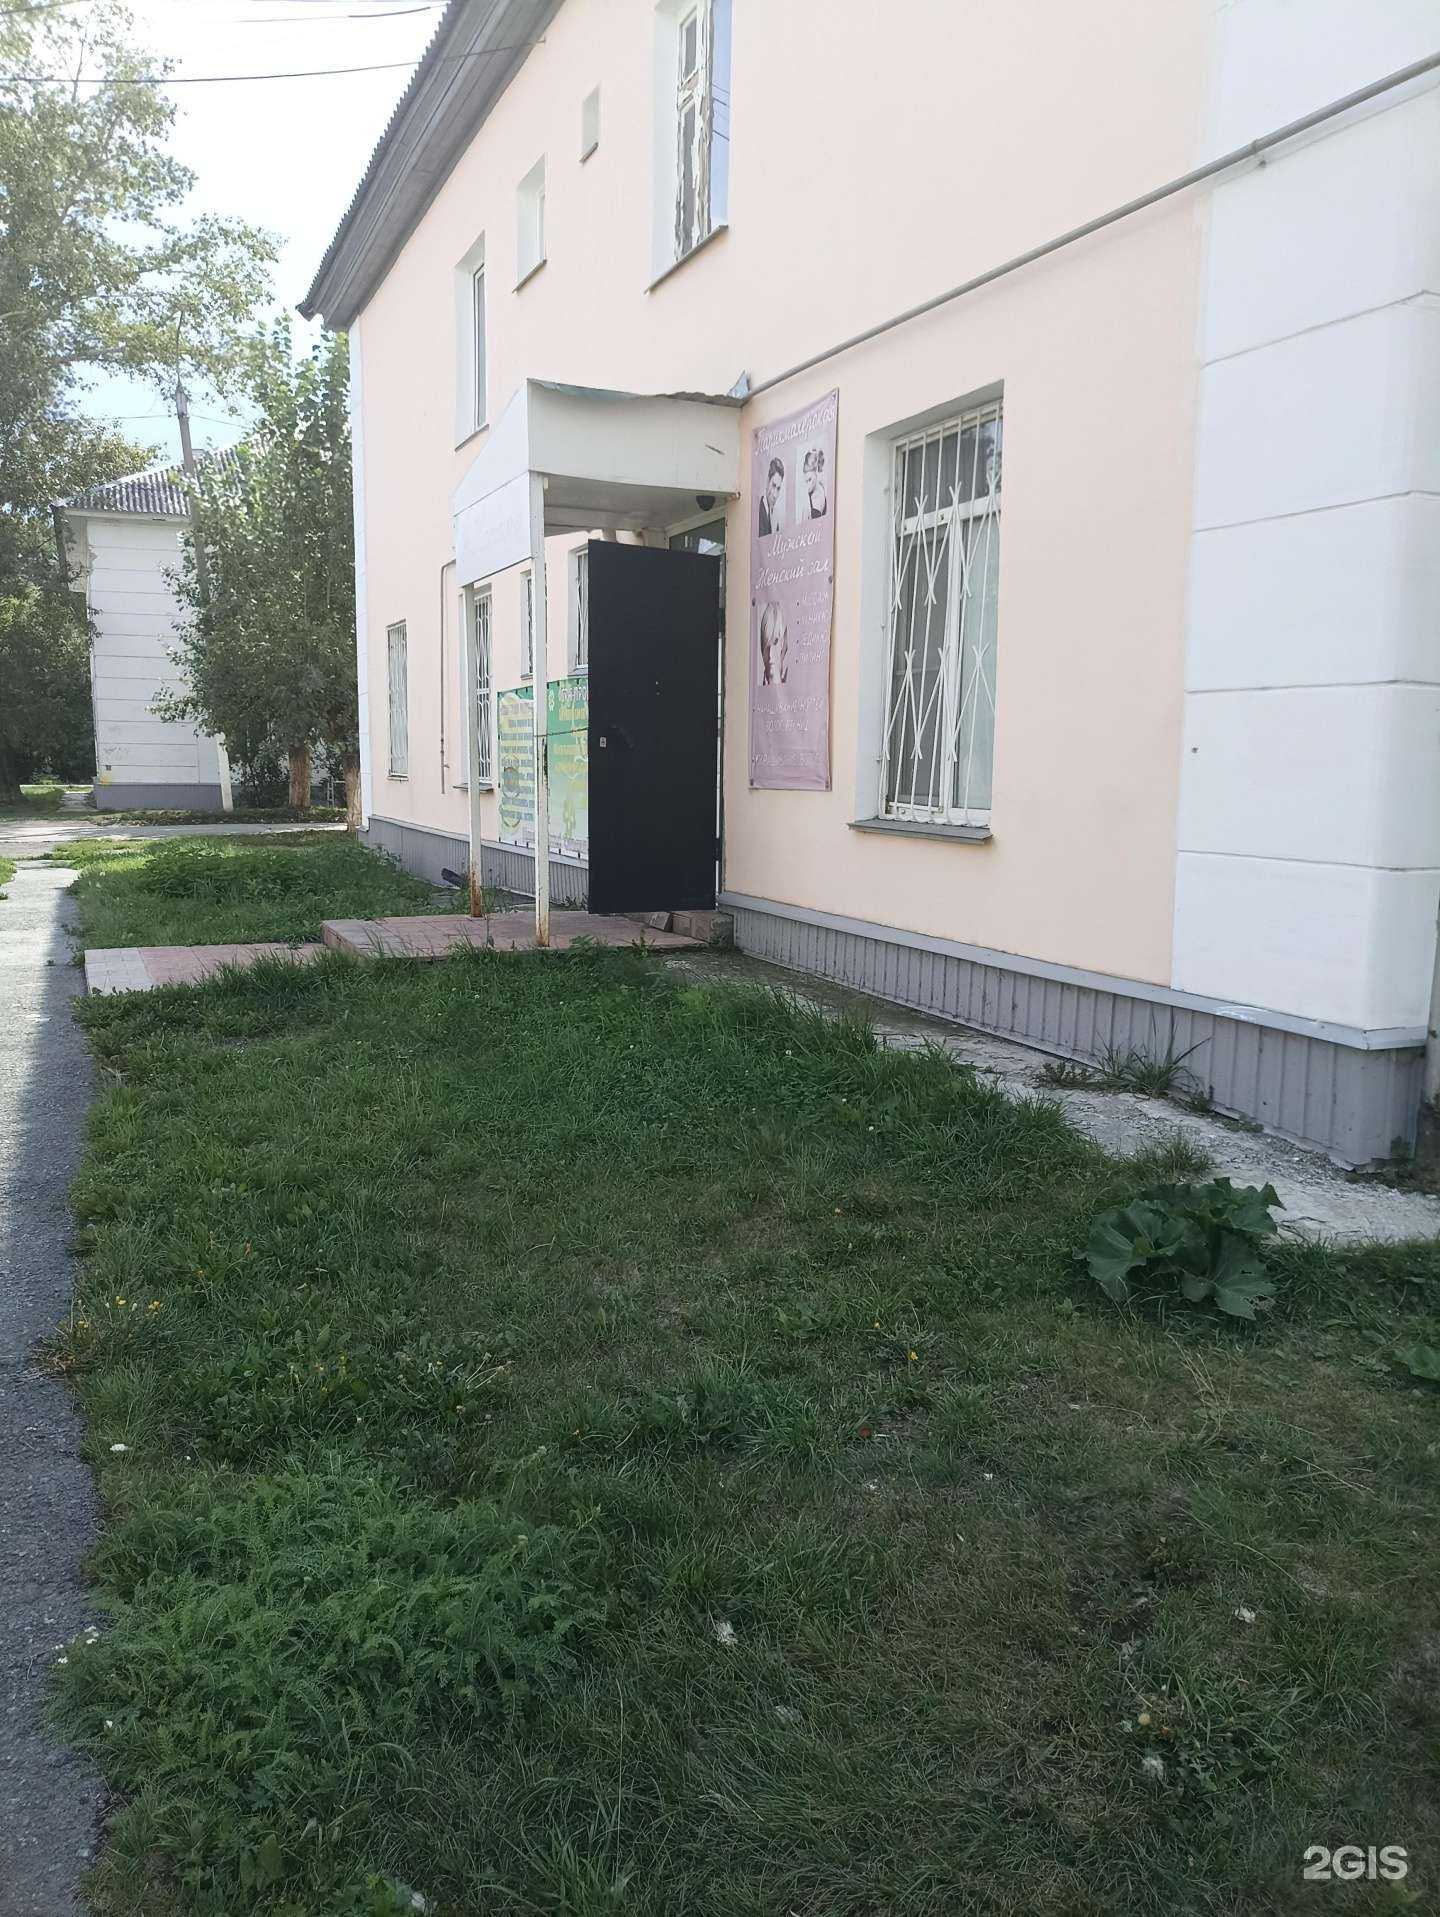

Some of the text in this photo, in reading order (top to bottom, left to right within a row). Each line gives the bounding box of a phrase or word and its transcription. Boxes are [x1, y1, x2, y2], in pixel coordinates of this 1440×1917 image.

[767, 528, 823, 560] Мужской
[755, 558, 830, 588] Женский зал
